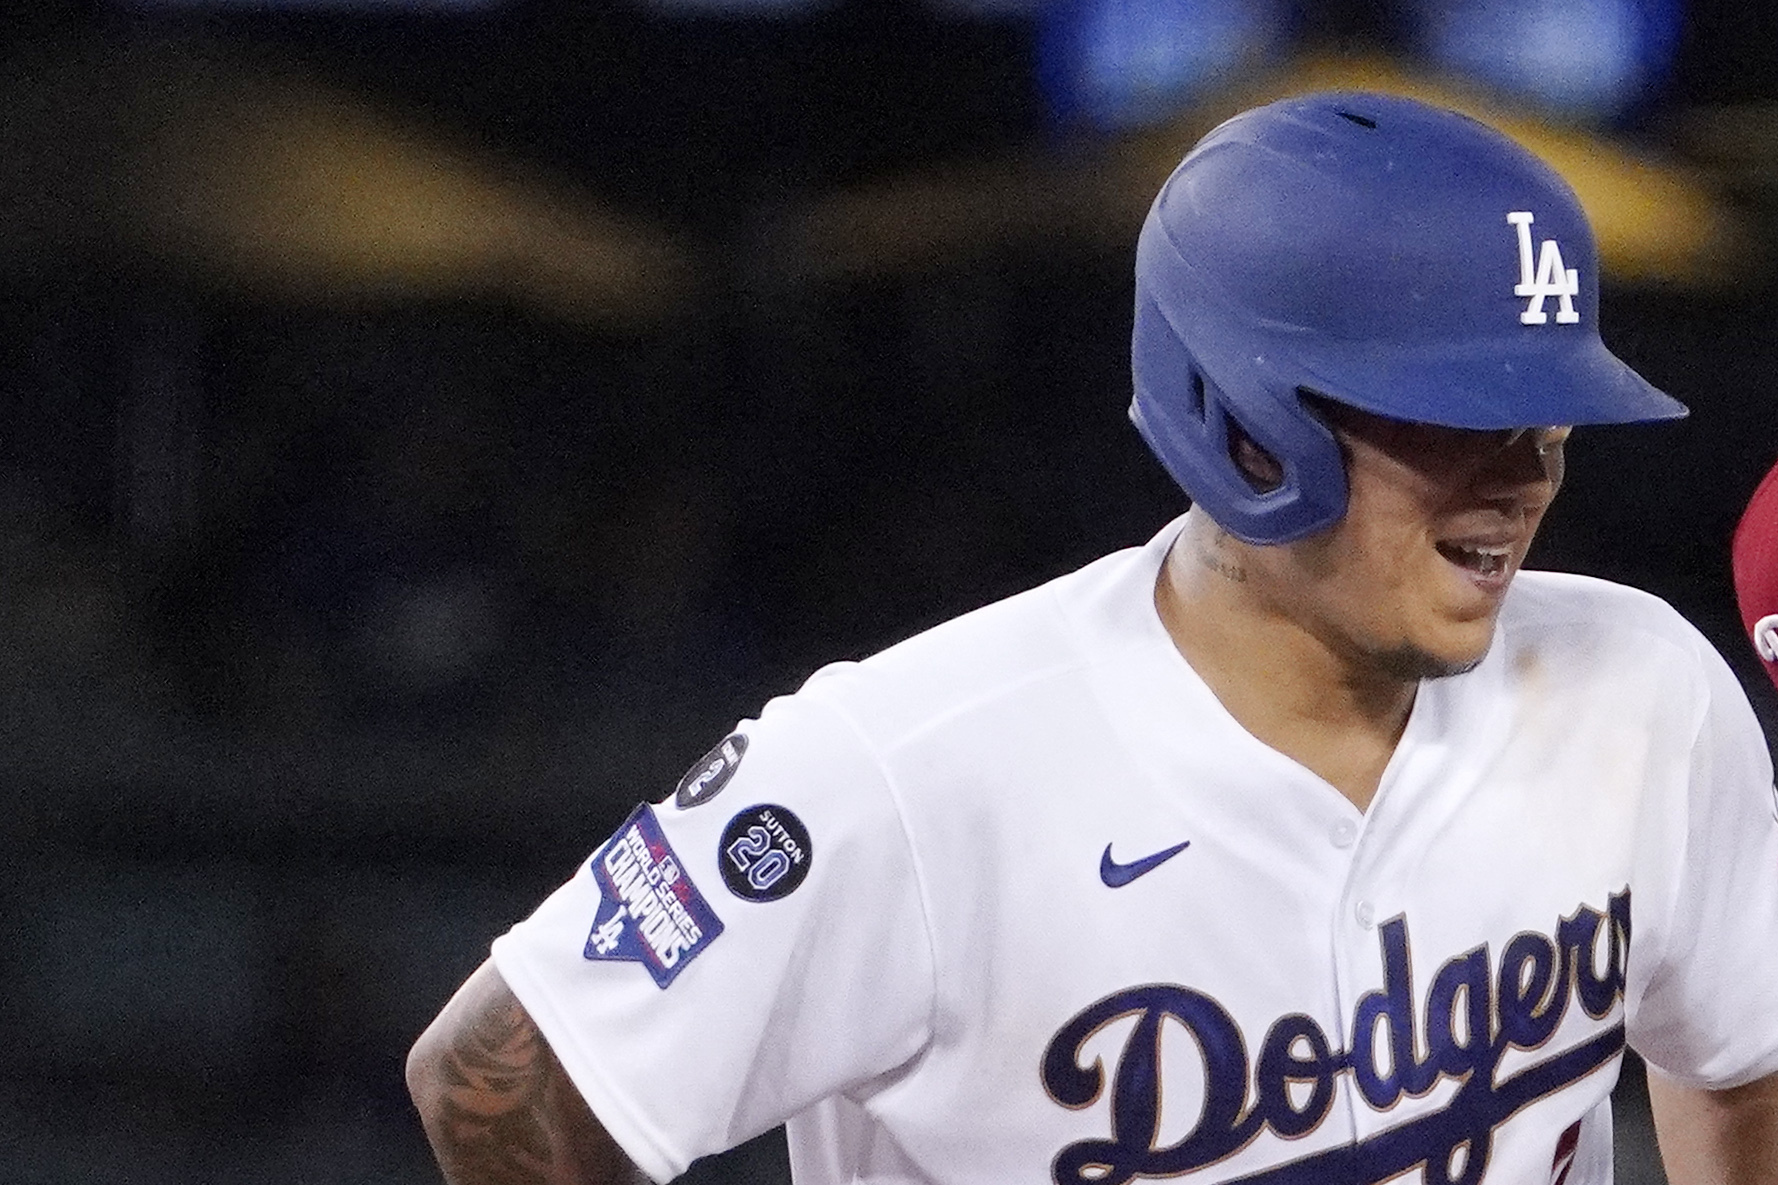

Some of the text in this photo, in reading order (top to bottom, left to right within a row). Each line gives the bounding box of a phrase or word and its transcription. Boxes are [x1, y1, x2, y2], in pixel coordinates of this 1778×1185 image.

[1506, 211, 1580, 324] LA
[726, 825, 790, 890] 20
[758, 810, 804, 864] SUTTON
[604, 838, 691, 969] CHAMPIONS
[626, 823, 703, 946] WORLD SERIES
[591, 905, 627, 954] LA
